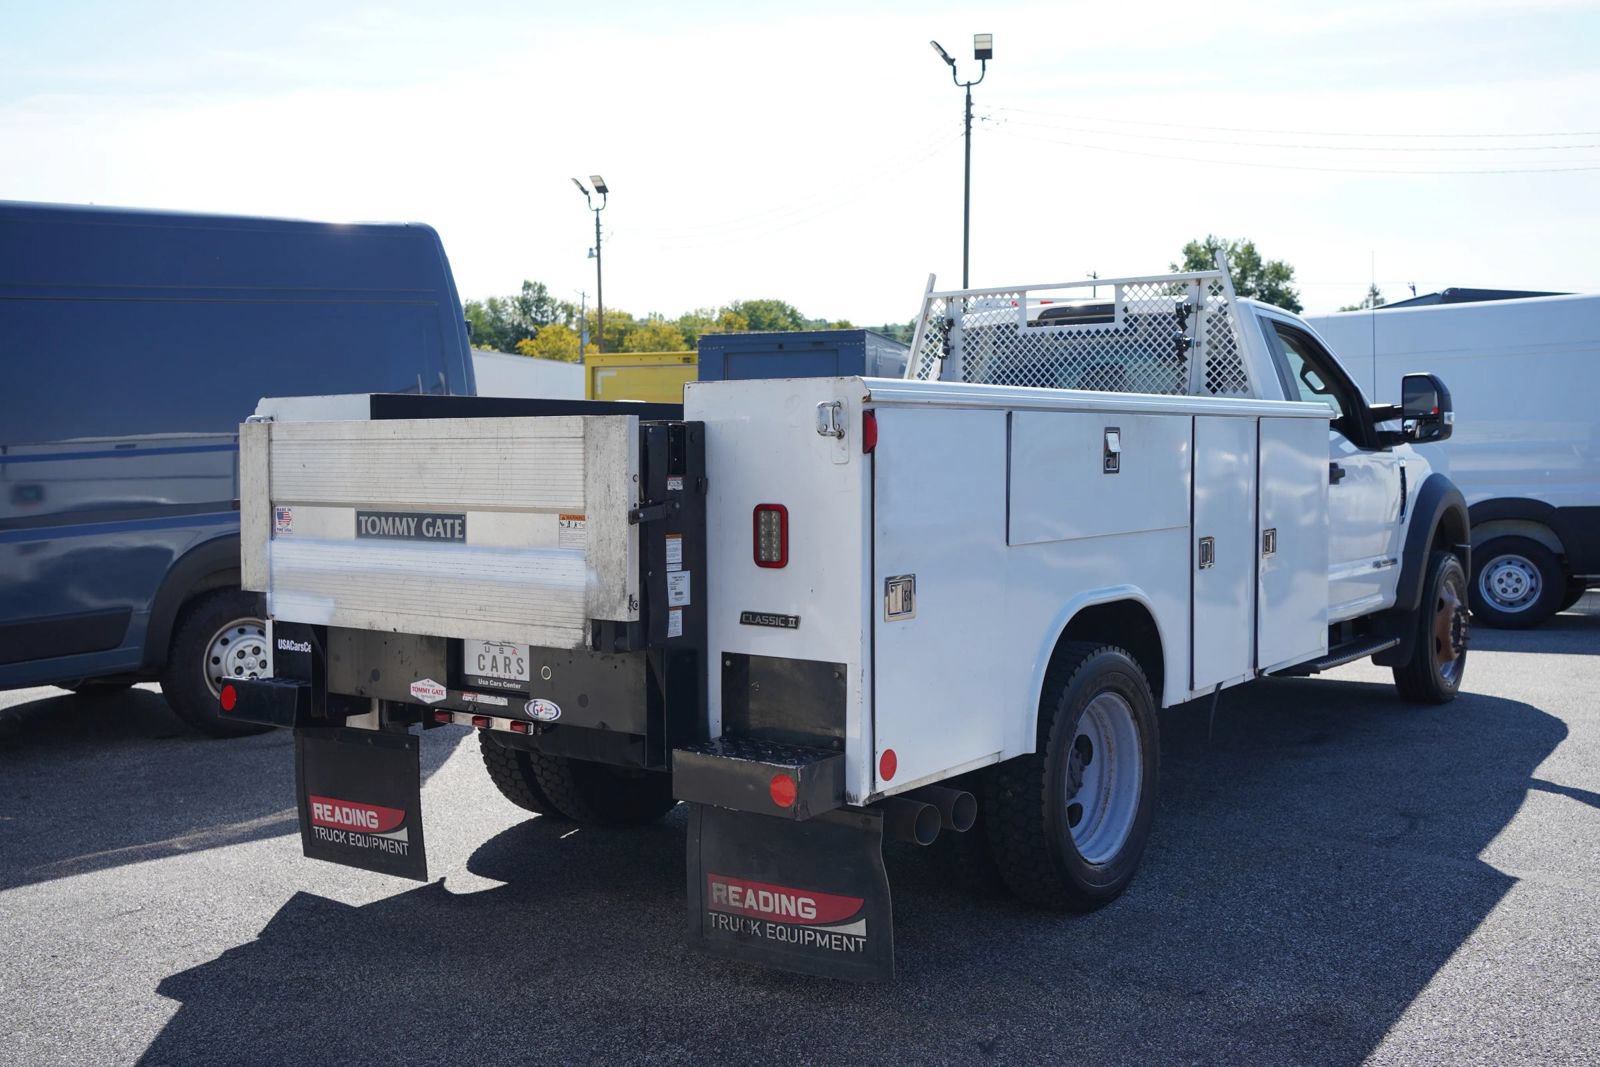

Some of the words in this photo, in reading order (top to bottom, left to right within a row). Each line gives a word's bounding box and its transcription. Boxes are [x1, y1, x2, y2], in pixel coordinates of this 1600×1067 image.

[359, 515, 418, 537] TOMMY
[421, 517, 464, 538] GATE
[742, 613, 786, 626] CLASSIC
[788, 617, 797, 627] II
[478, 653, 524, 675] CARS
[412, 686, 431, 695] TOMMY
[431, 688, 445, 696] GATE
[489, 680, 502, 688] Cars
[502, 681, 521, 689] Center
[312, 802, 379, 829] READING
[313, 826, 348, 845] TRUCK
[348, 832, 409, 856] EQUIPMENT
[711, 882, 817, 920] READING
[708, 912, 762, 938] TRUCK
[766, 923, 867, 953] EQUIPMENT
